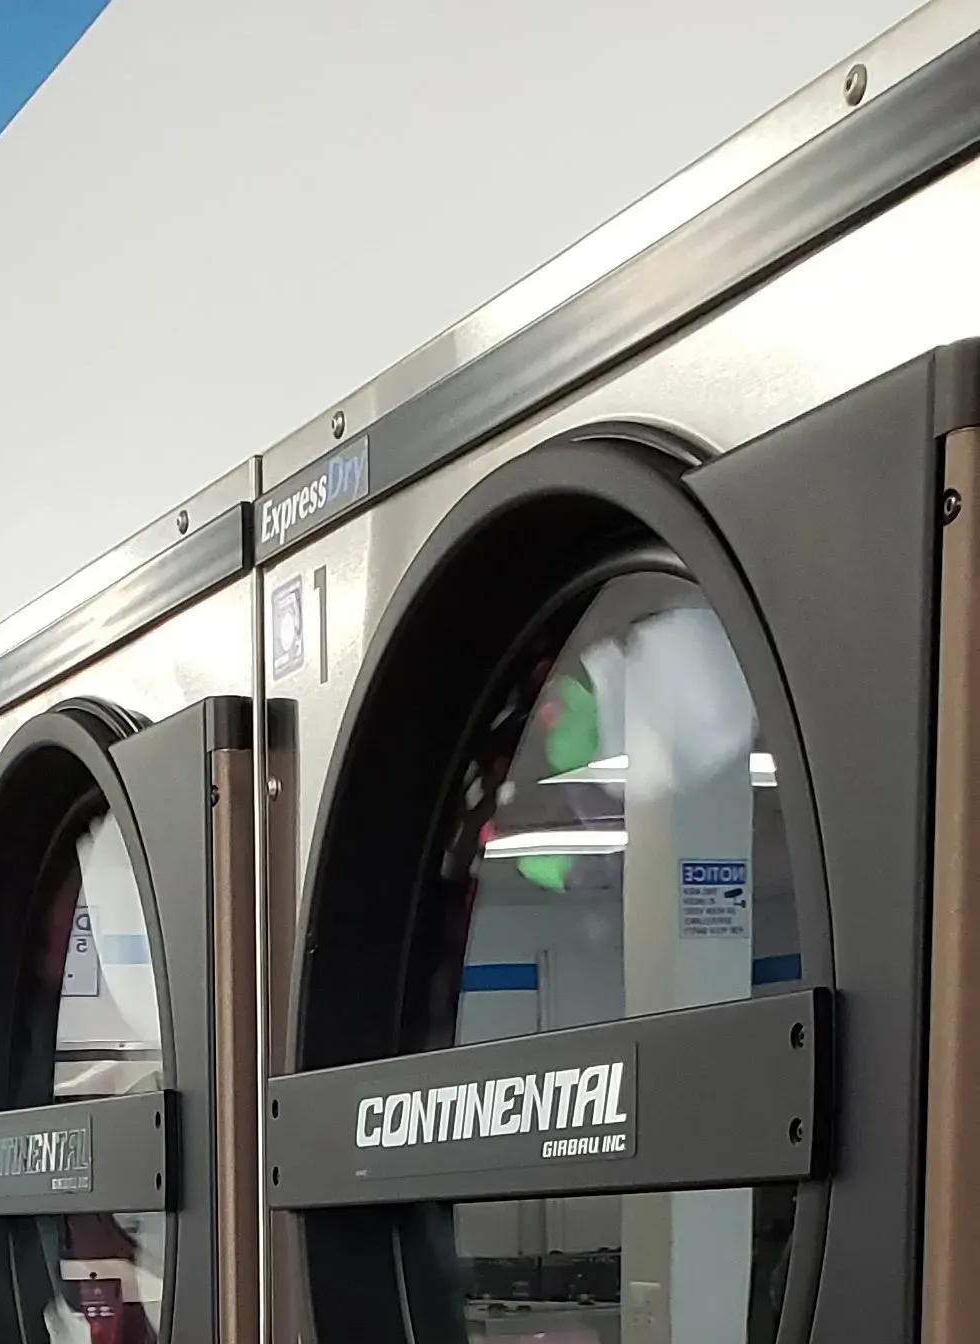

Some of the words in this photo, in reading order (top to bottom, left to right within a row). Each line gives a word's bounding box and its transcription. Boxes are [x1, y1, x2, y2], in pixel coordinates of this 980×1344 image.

[314, 564, 328, 684] 1
[356, 1062, 627, 1148] CONTINENTAL
[542, 1137, 599, 1158] GIRBAU
[602, 1134, 626, 1152] INC
